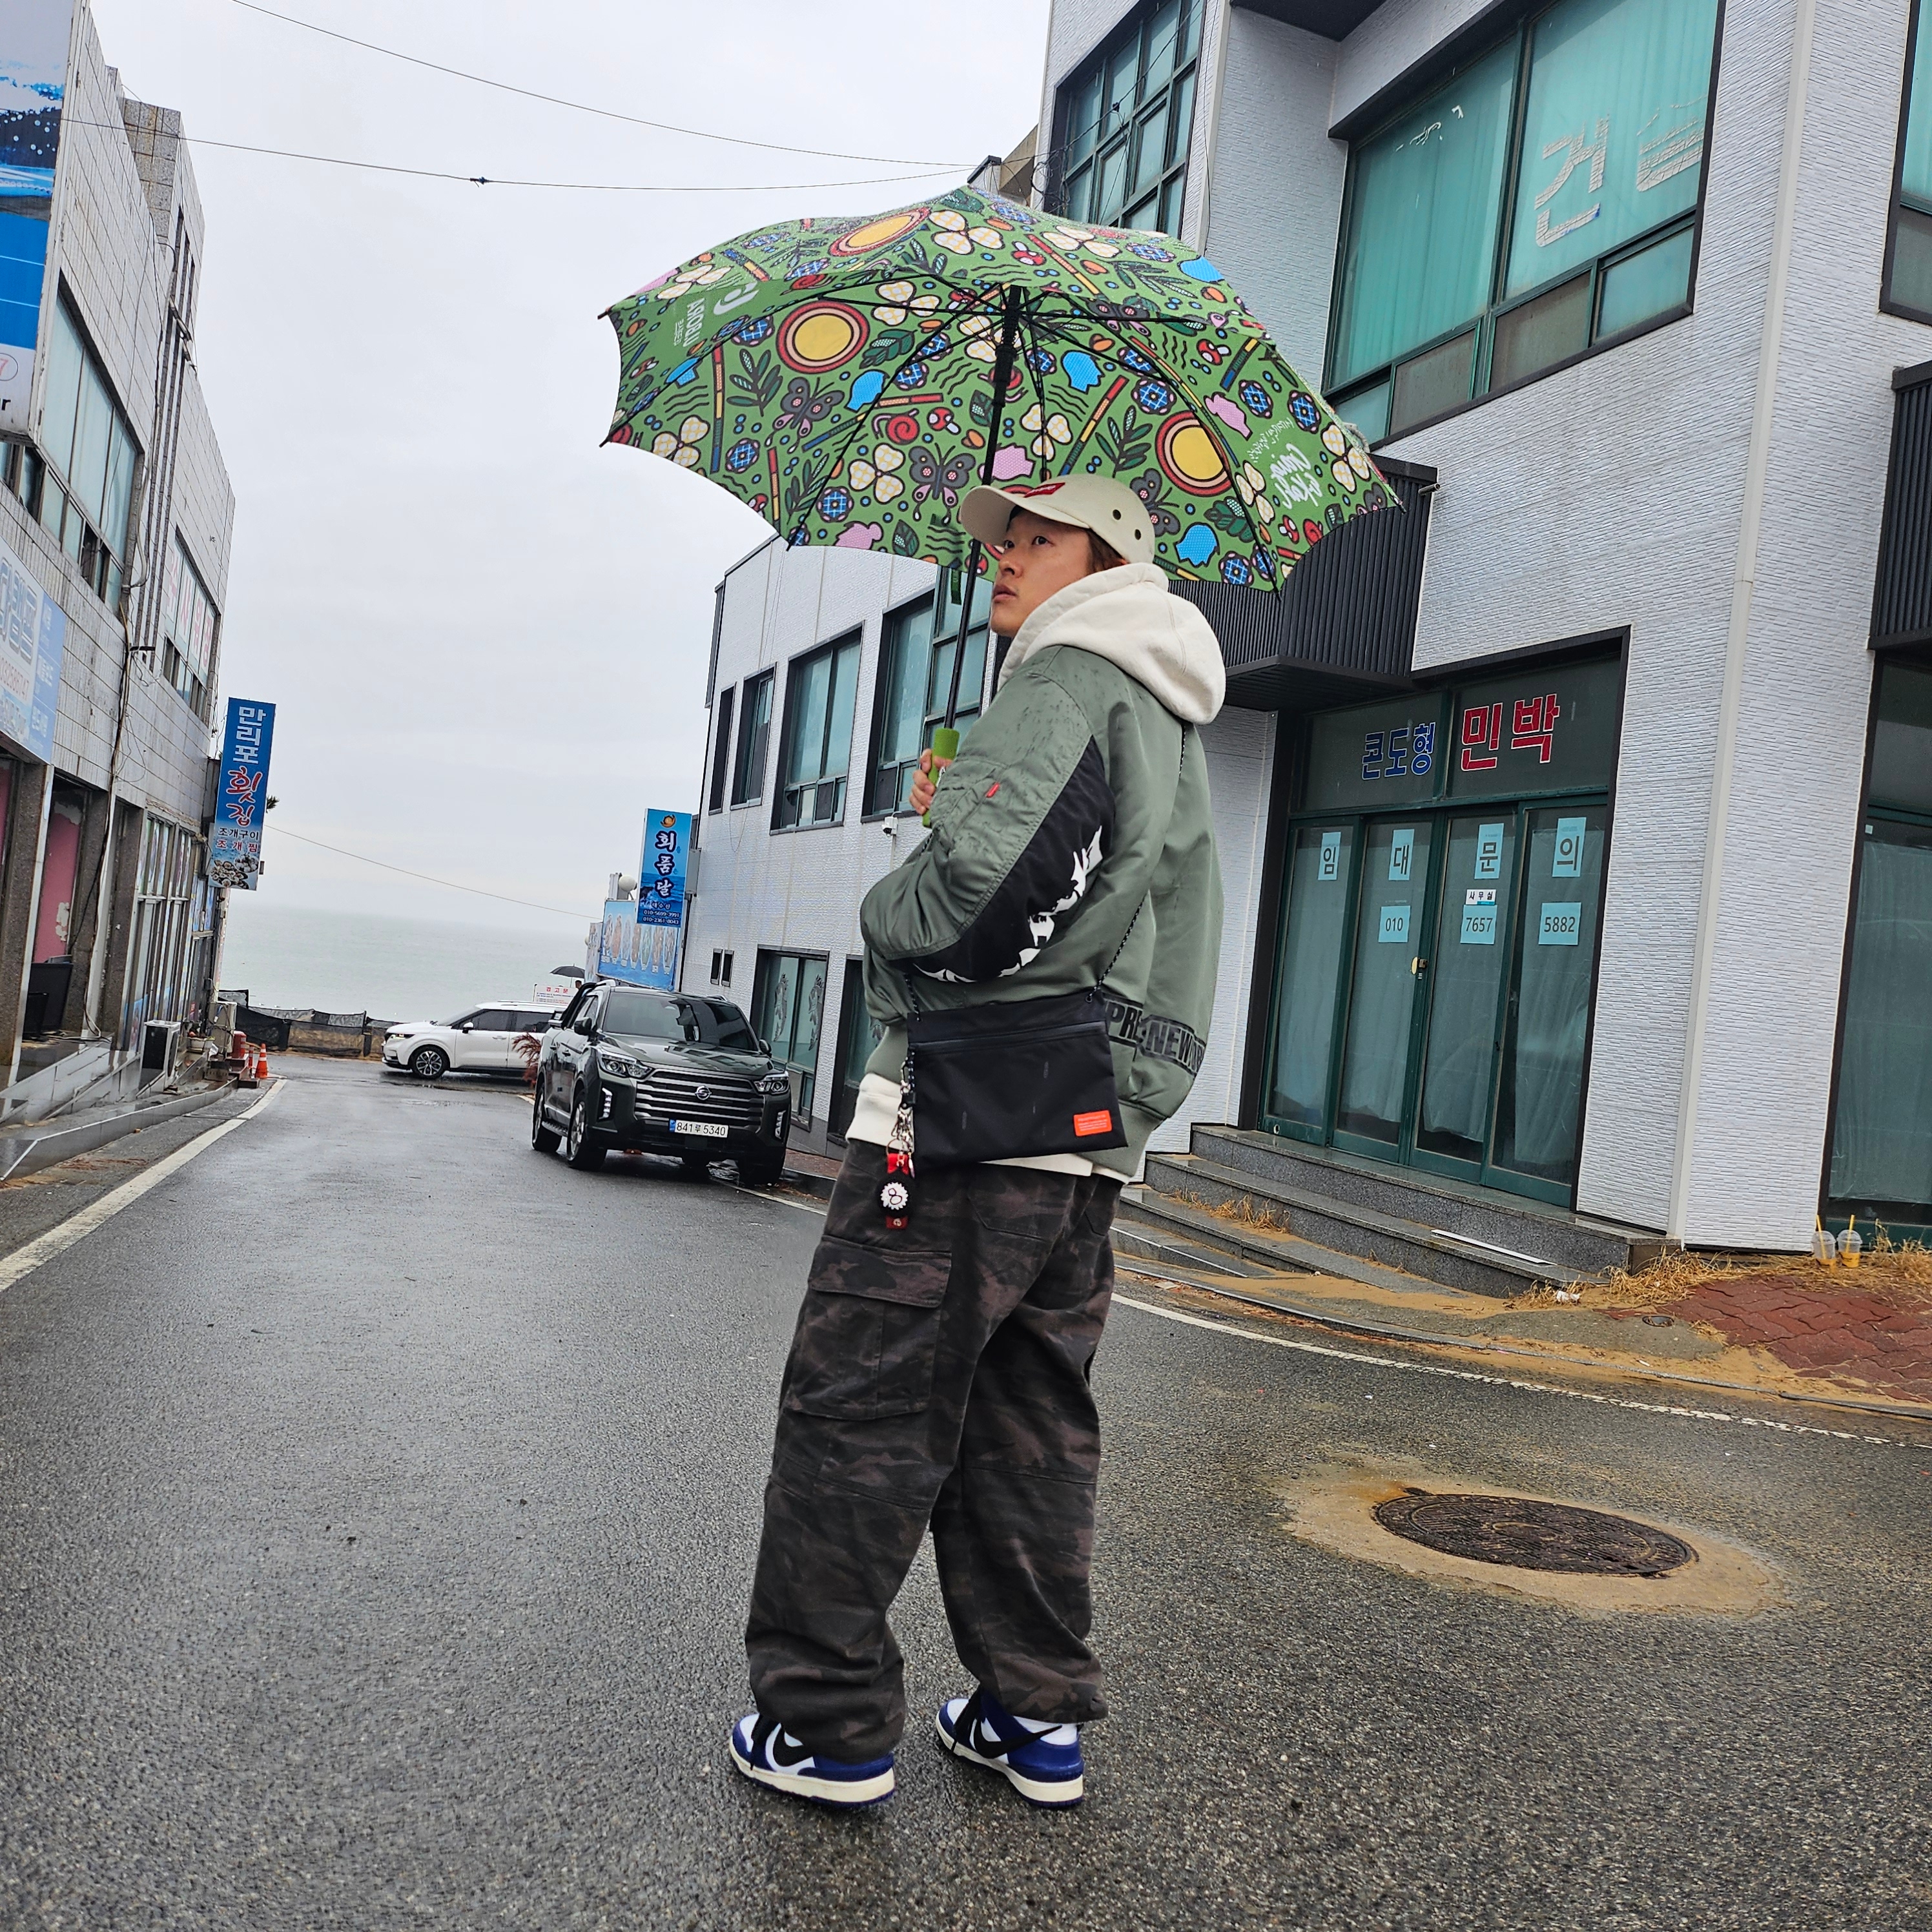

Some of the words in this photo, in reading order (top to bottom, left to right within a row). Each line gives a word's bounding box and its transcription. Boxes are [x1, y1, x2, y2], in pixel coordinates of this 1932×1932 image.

[233, 706, 267, 765] 만리포
[1362, 722, 1435, 780] 콘도형
[1461, 694, 1560, 772] 민박
[226, 765, 262, 826] 횟집
[218, 827, 258, 841] 조개구이
[655, 831, 676, 898] 회품달
[1468, 891, 1493, 900] 사무실
[1385, 916, 1403, 932] 010
[1465, 917, 1493, 933] 7657
[1544, 916, 1576, 933] 5882
[703, 1124, 726, 1136] 5340
